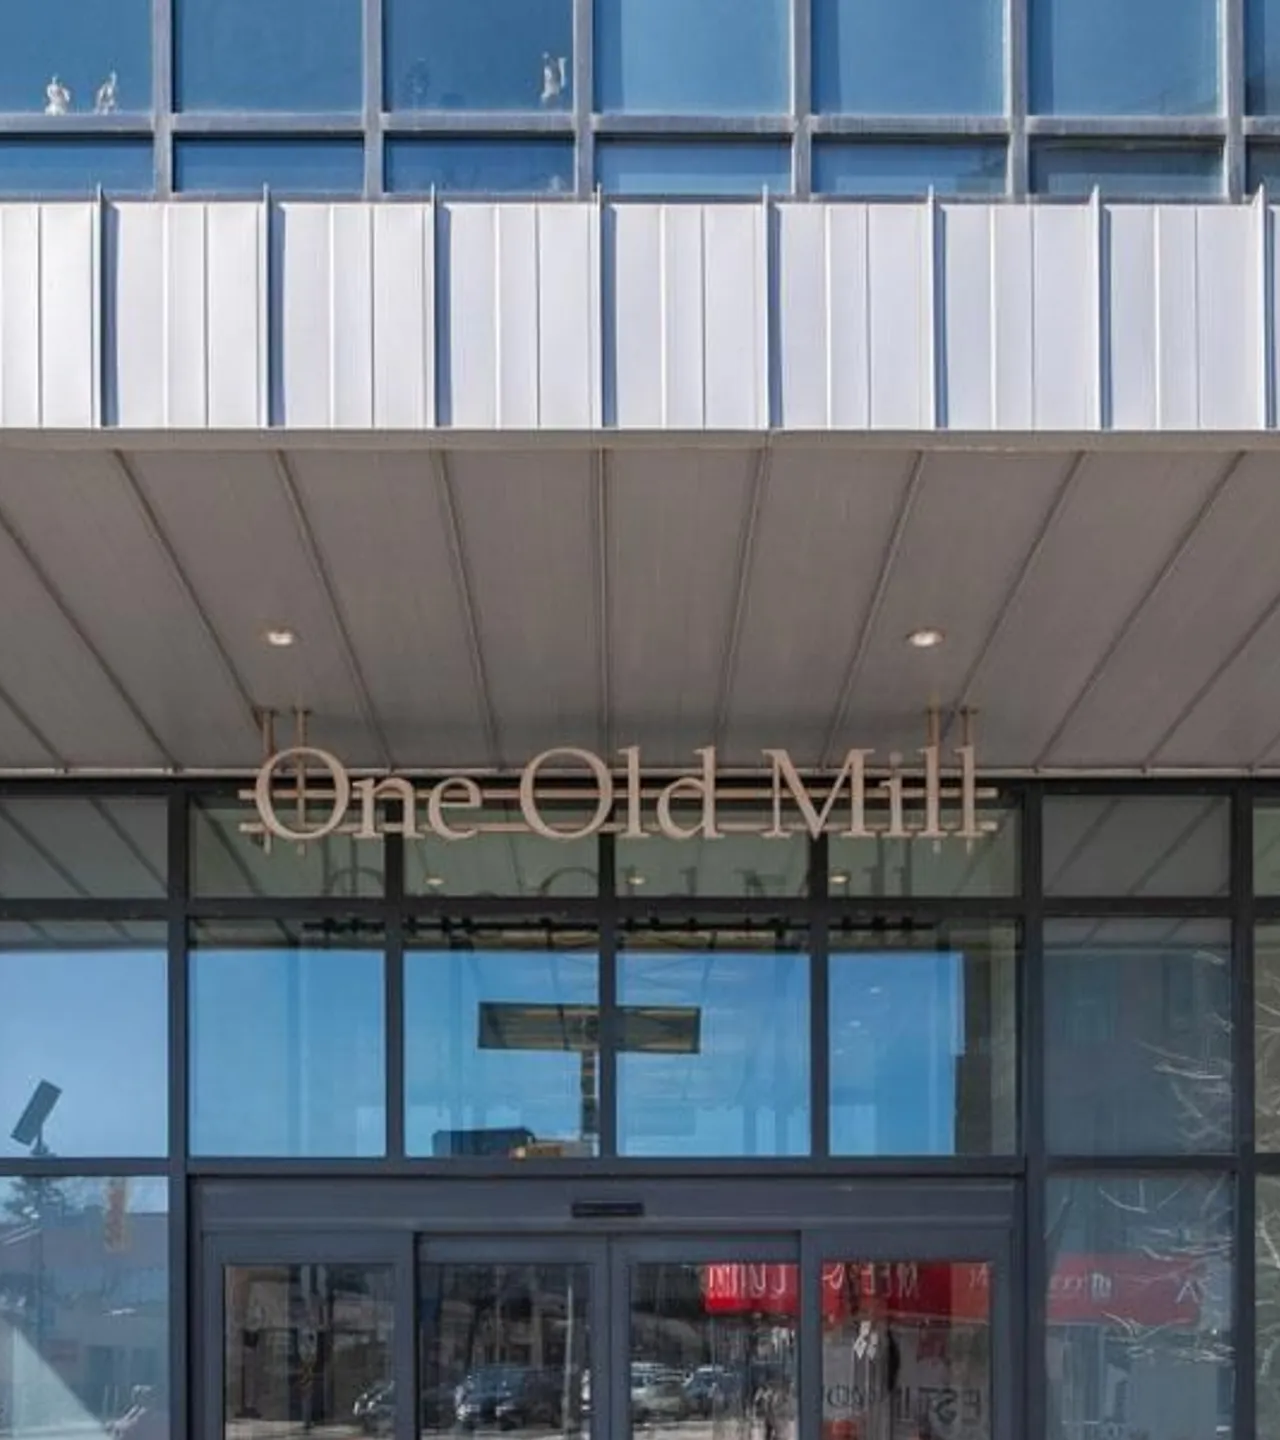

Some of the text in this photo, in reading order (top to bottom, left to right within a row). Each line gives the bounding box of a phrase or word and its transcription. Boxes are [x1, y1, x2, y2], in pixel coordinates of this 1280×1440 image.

[253, 744, 982, 842] One Old Mill
